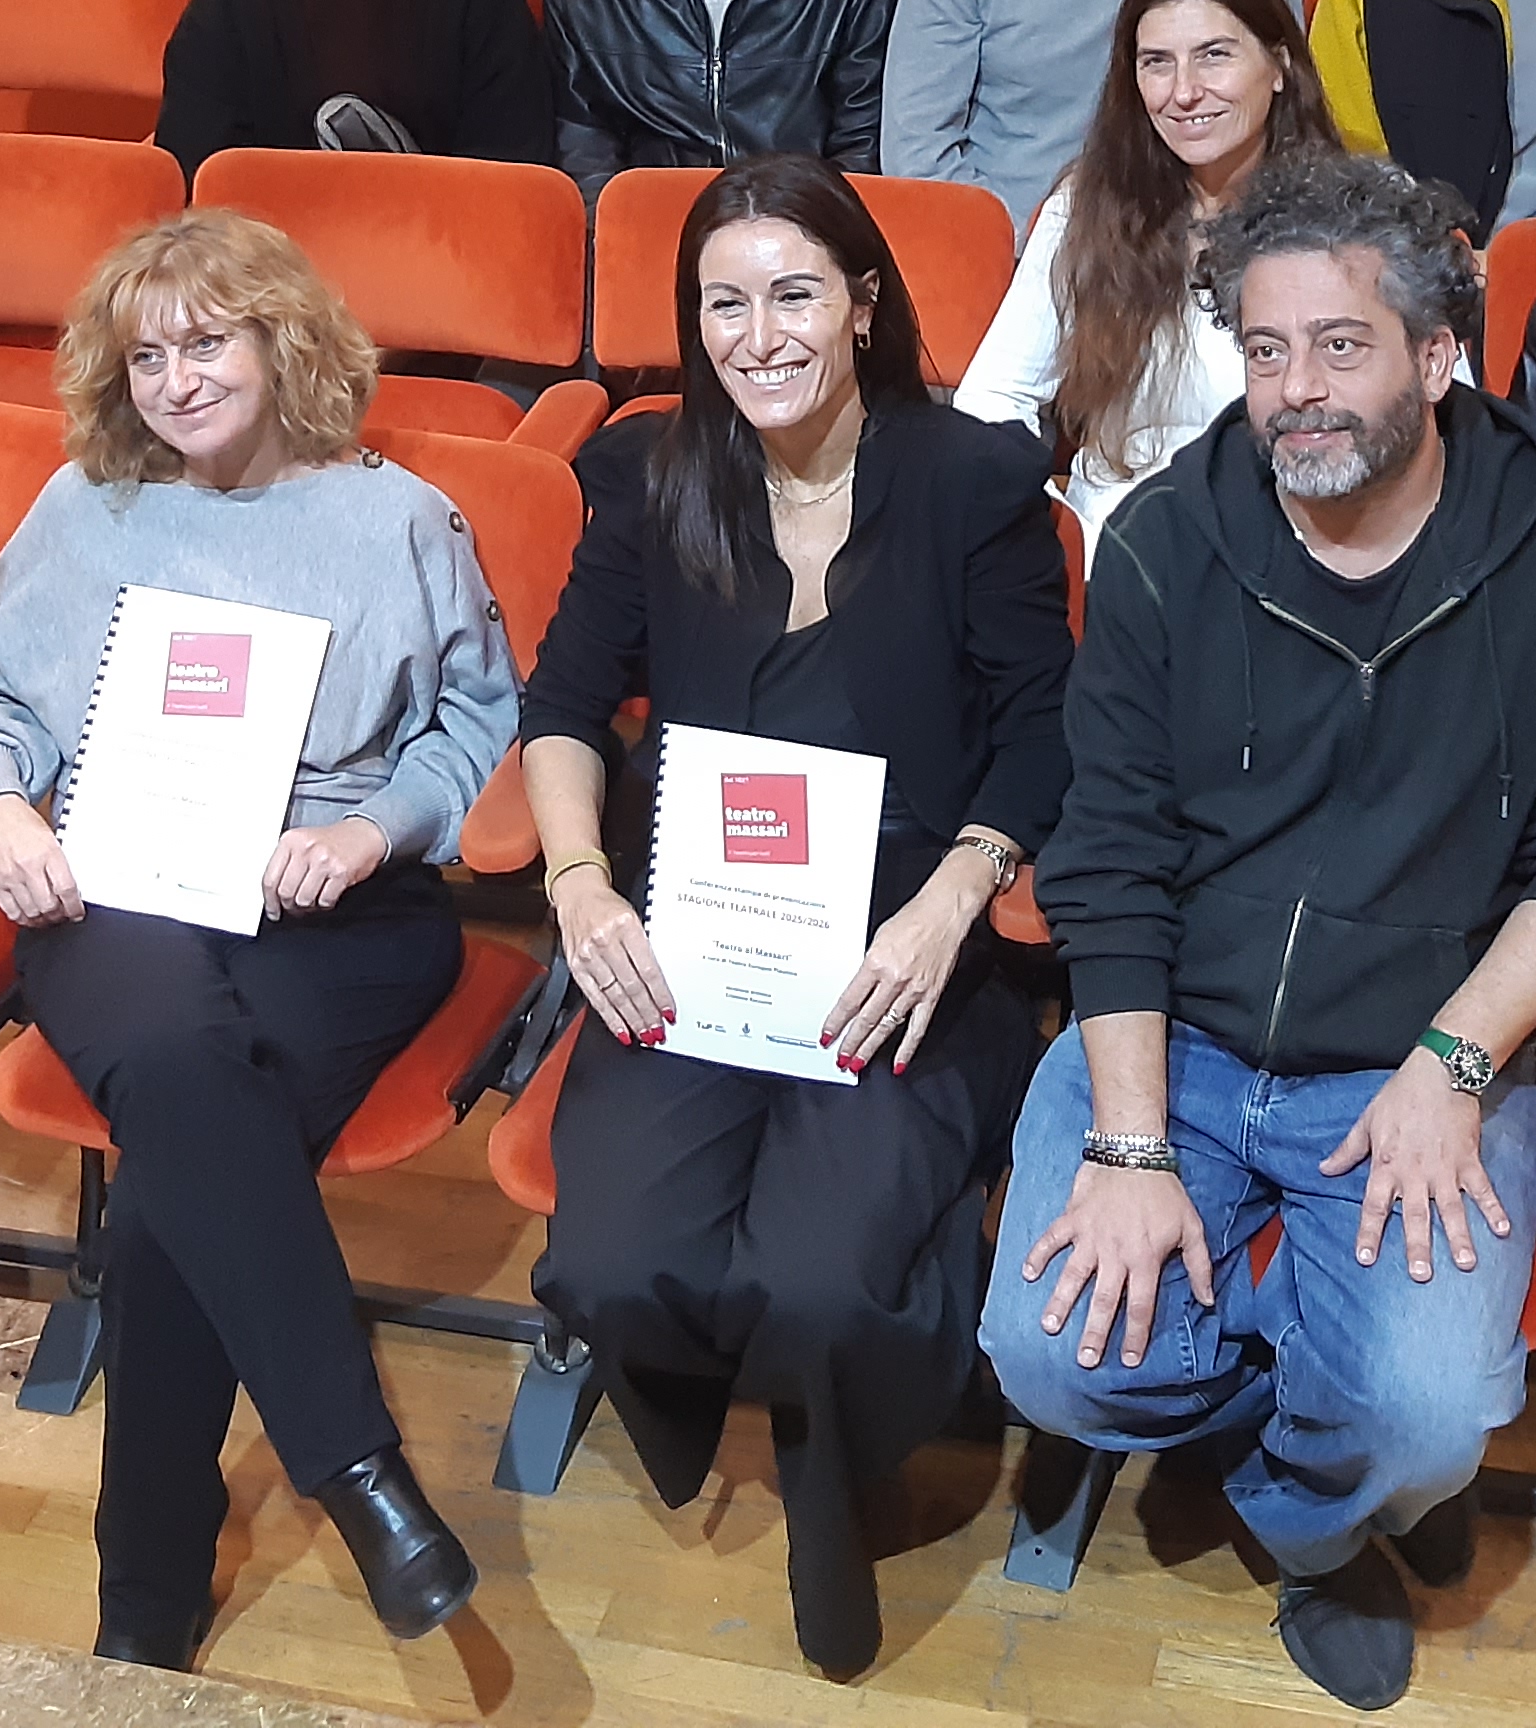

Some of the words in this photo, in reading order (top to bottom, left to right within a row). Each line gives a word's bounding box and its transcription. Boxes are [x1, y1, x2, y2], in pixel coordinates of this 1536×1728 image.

[725, 806, 777, 823] teatro
[726, 821, 789, 838] massari
[677, 893, 726, 910] STAGIONE
[730, 902, 777, 920] TEATRALE
[781, 912, 831, 929] 2025/2026
